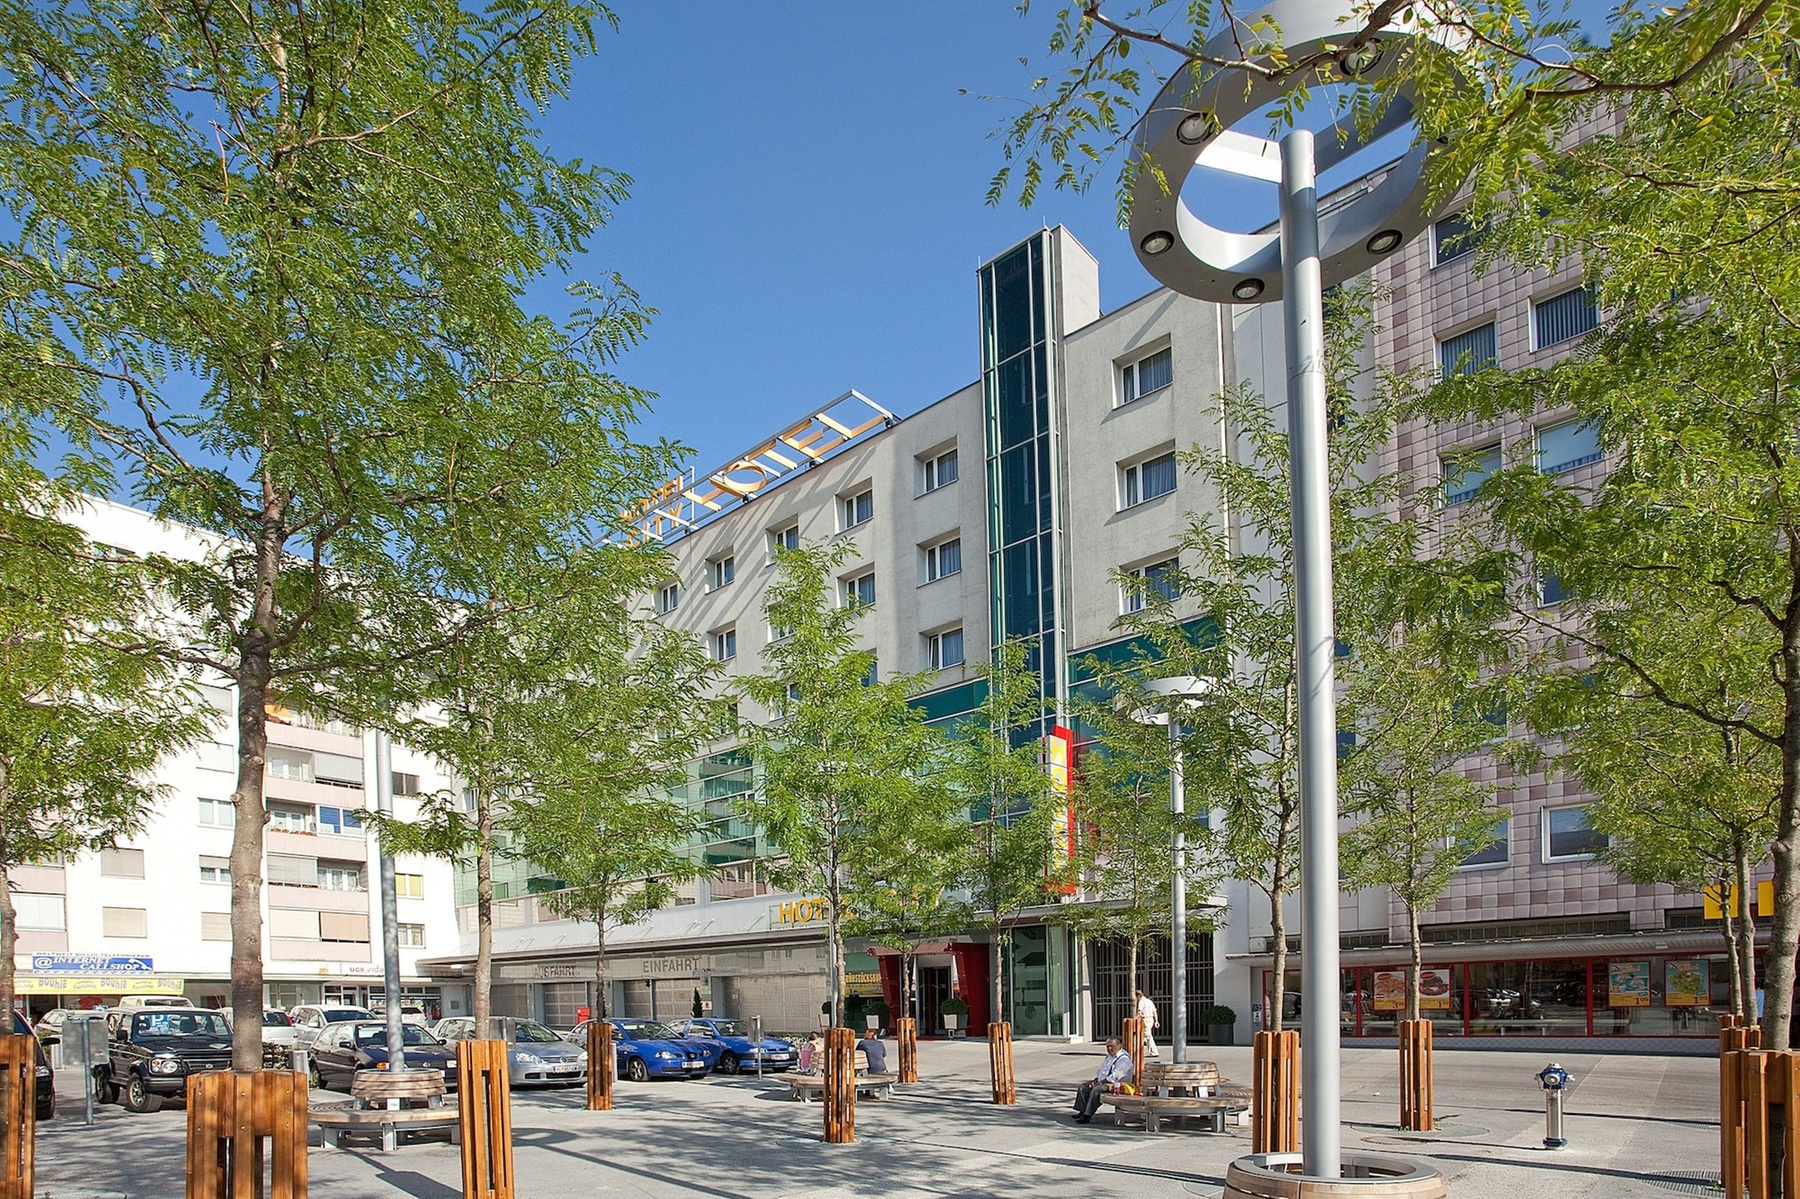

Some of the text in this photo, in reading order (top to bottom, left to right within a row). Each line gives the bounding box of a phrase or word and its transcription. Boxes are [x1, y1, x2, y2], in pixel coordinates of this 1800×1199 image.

[778, 897, 858, 924] HOTL
[53, 956, 112, 964] INTERNET
[642, 957, 700, 973] EINFAHRT
[533, 965, 576, 978] AUSFAHRT
